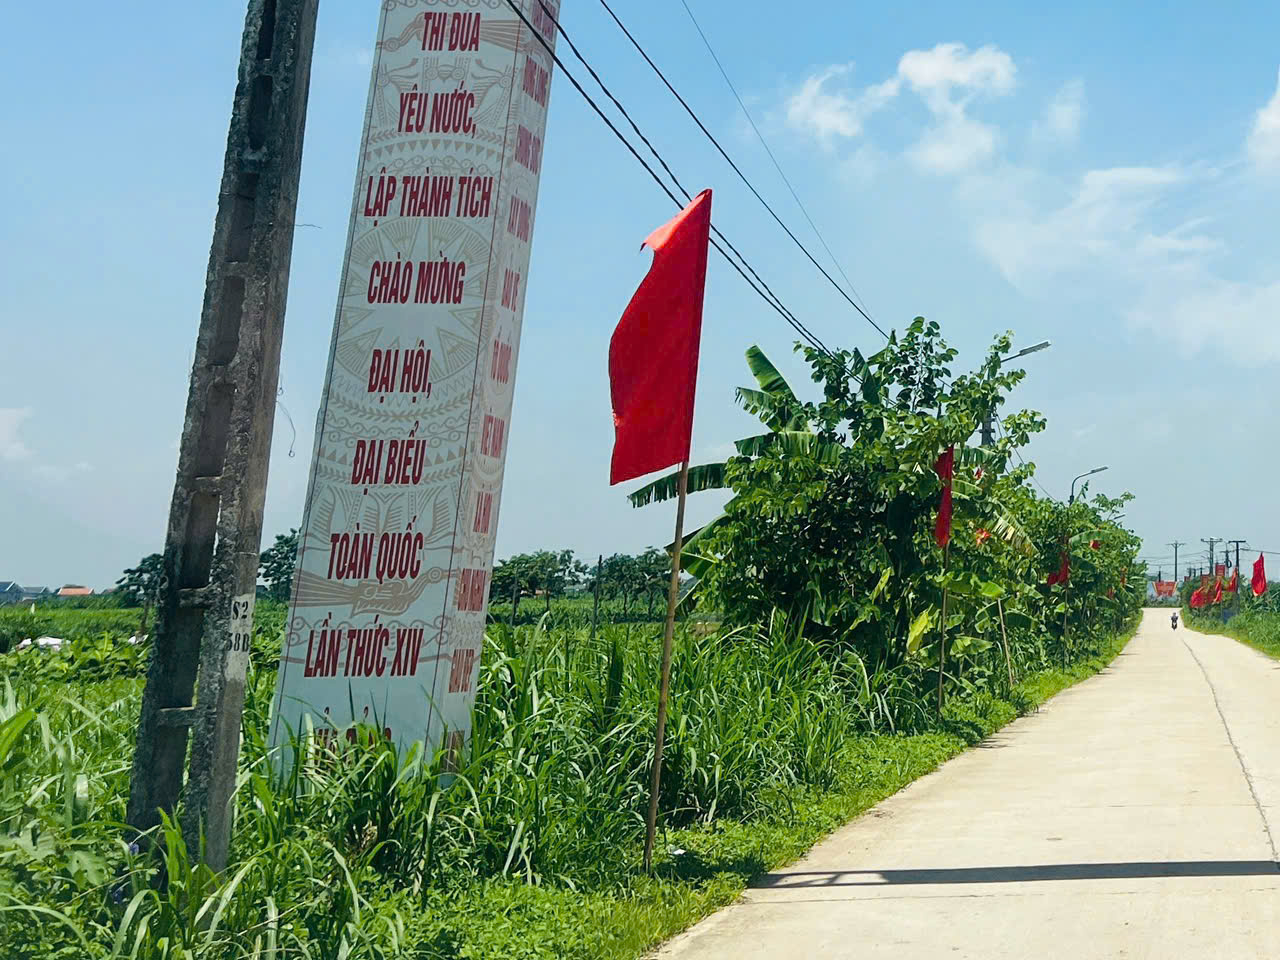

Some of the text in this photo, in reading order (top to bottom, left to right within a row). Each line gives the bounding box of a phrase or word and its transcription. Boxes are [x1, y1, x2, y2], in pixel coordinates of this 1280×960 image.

[421, 11, 447, 51] THI
[398, 80, 476, 138] YÊU NƯỚC,
[364, 167, 397, 226] LẬP
[400, 167, 453, 217] THÀNH
[456, 168, 493, 217] TÍCH
[367, 250, 466, 305] CHÀO MỪNG
[368, 349, 399, 403] ĐẠI
[400, 340, 432, 403] HỘI,
[351, 420, 426, 495] ĐẠI BIỂU
[327, 515, 424, 584] TOÀN QUỐC
[304, 612, 342, 677] LẦN
[344, 614, 391, 677] THỨC
[391, 628, 424, 677] XIV
